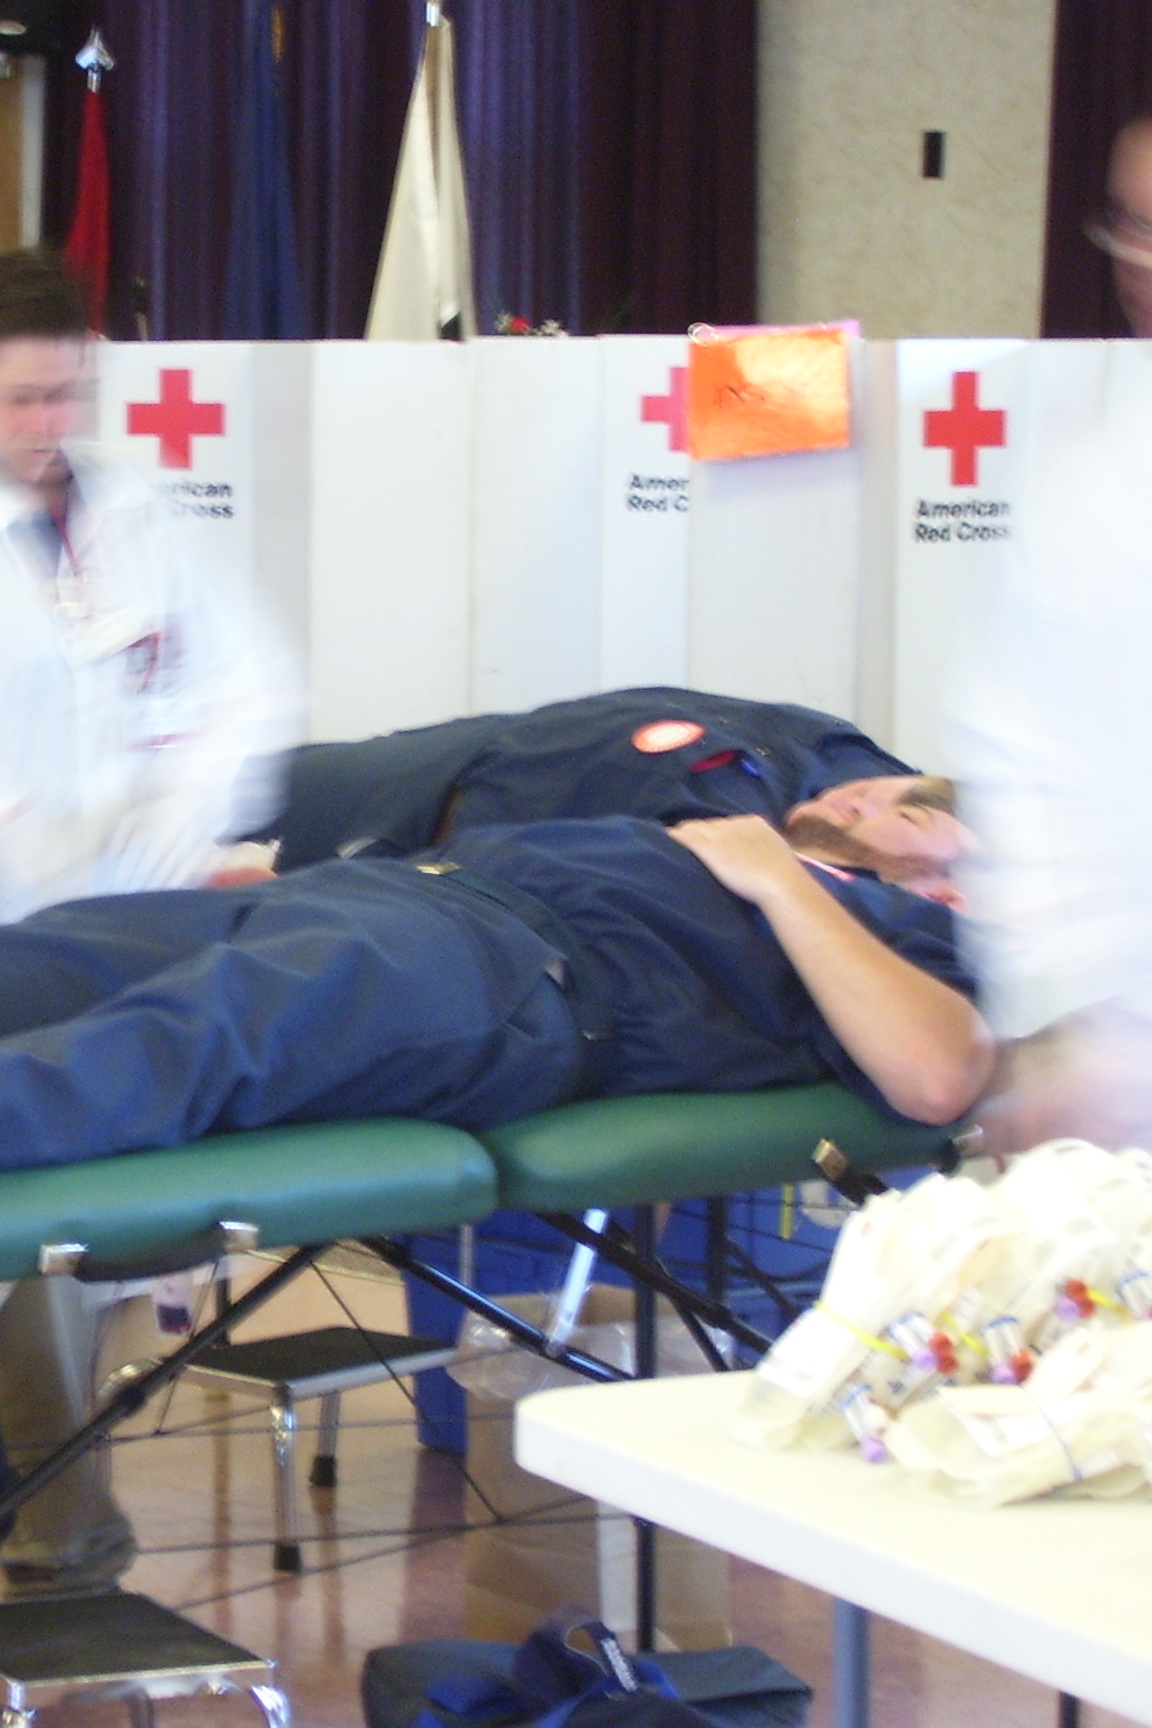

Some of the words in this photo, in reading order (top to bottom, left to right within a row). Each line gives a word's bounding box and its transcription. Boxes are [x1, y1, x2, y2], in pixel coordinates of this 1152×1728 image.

[628, 495, 668, 511] Red
[915, 499, 1009, 517] American
[914, 523, 950, 541] Red
